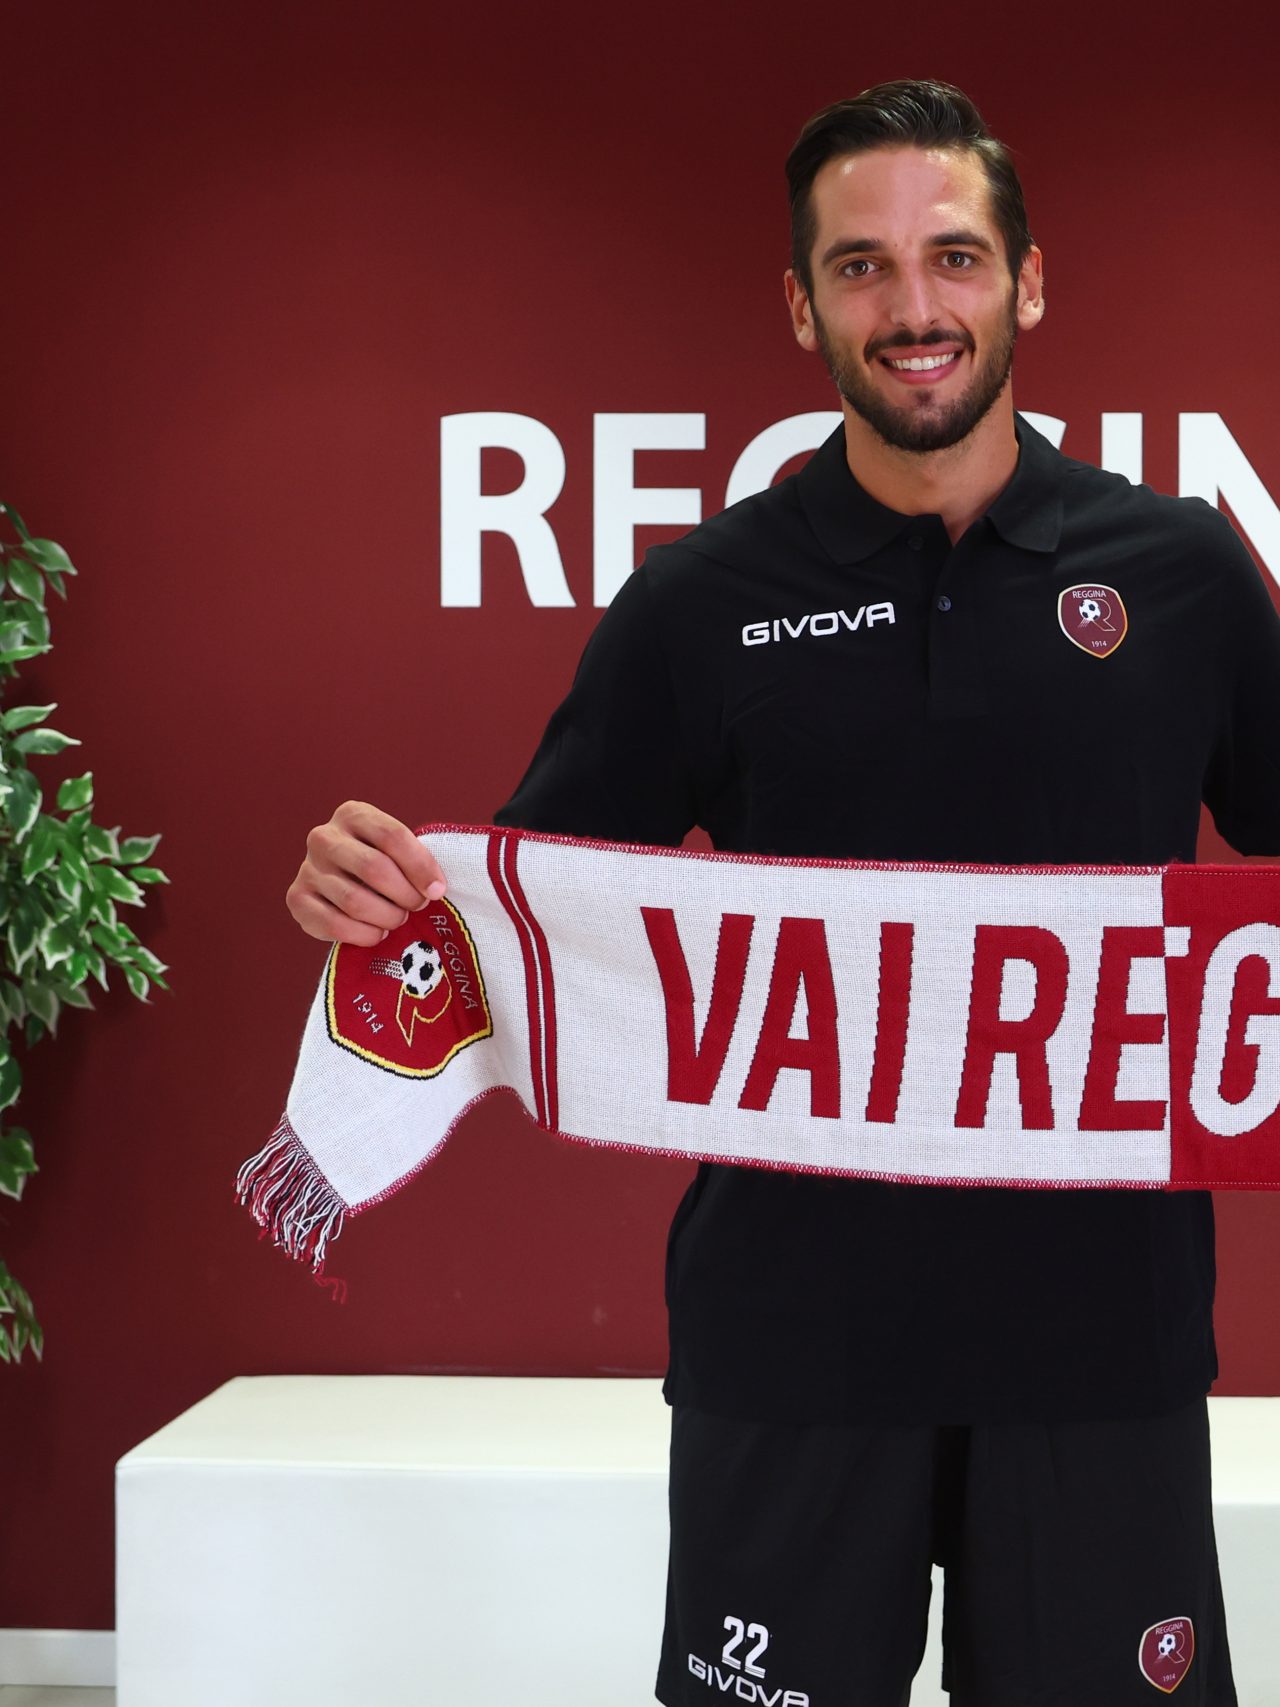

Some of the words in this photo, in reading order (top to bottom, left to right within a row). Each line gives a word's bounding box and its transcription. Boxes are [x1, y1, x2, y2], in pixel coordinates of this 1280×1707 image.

[1072, 590, 1107, 599] REGGINA
[741, 601, 896, 647] GIVOVA
[1091, 640, 1107, 648] 1914
[429, 914, 479, 1010] REGGINA
[352, 993, 384, 1034] 1914
[640, 906, 914, 1124] VAI
[722, 1615, 769, 1679] 22
[1155, 1621, 1184, 1636] REGGINA
[688, 1653, 810, 1707] GIVOVA
